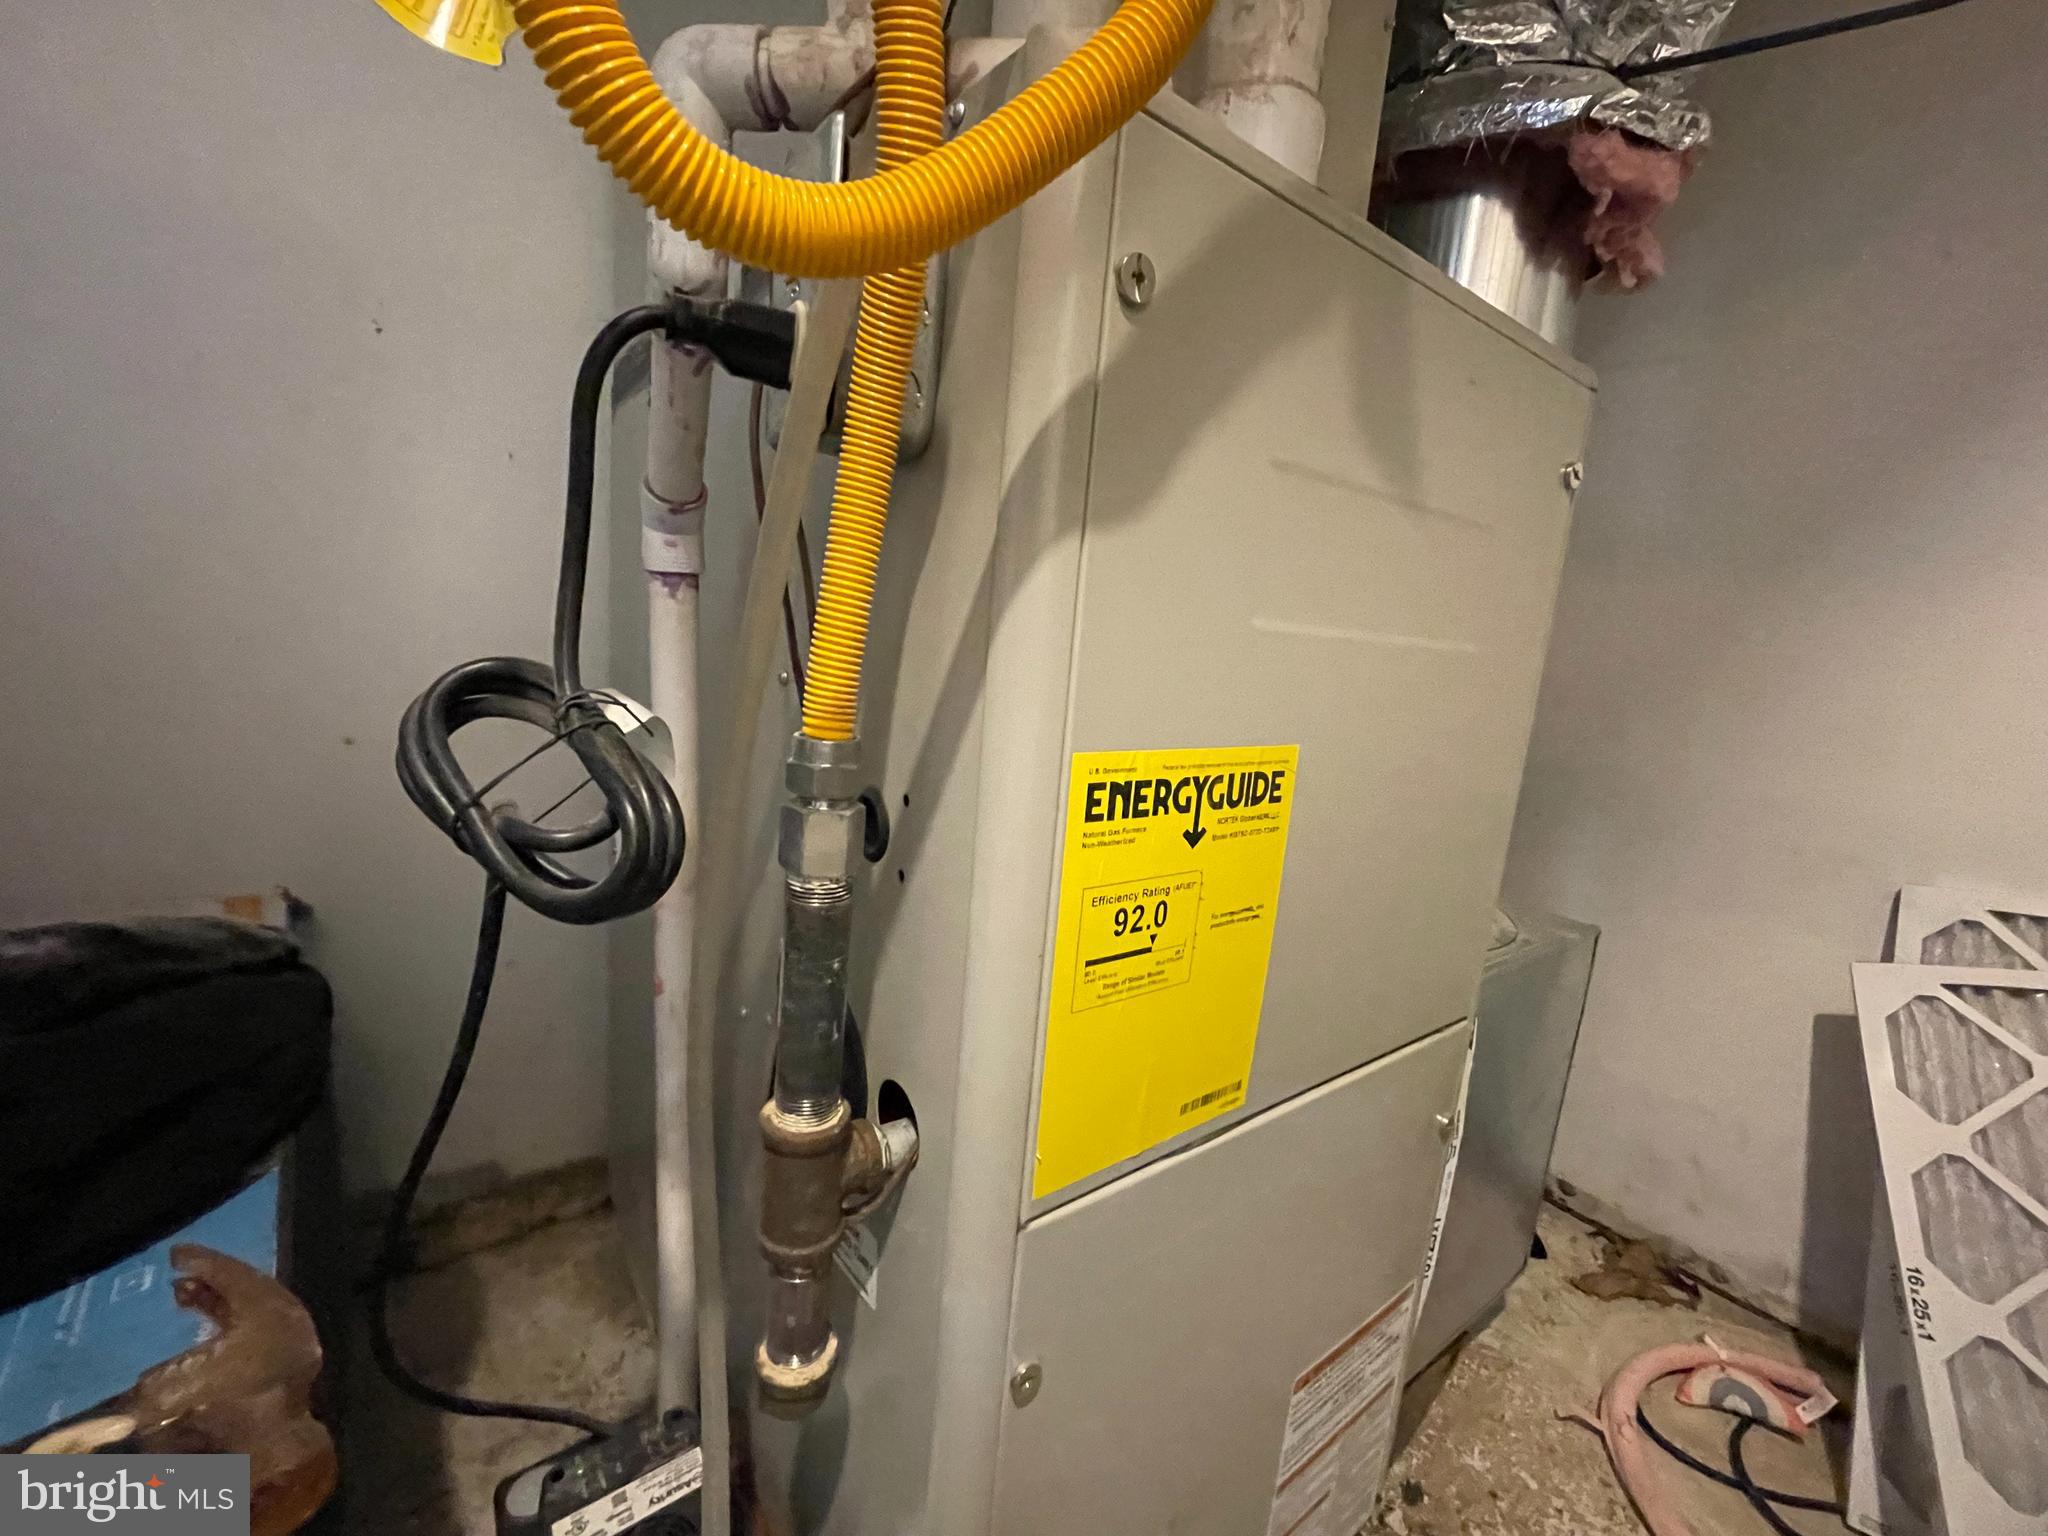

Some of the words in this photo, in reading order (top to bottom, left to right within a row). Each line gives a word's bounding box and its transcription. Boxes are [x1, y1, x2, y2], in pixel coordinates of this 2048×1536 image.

[1084, 770, 1285, 849] ENERGYGUIDE
[1091, 891, 1139, 907] Efficiency
[1142, 886, 1171, 898] Rating
[1113, 899, 1168, 937] 92.0
